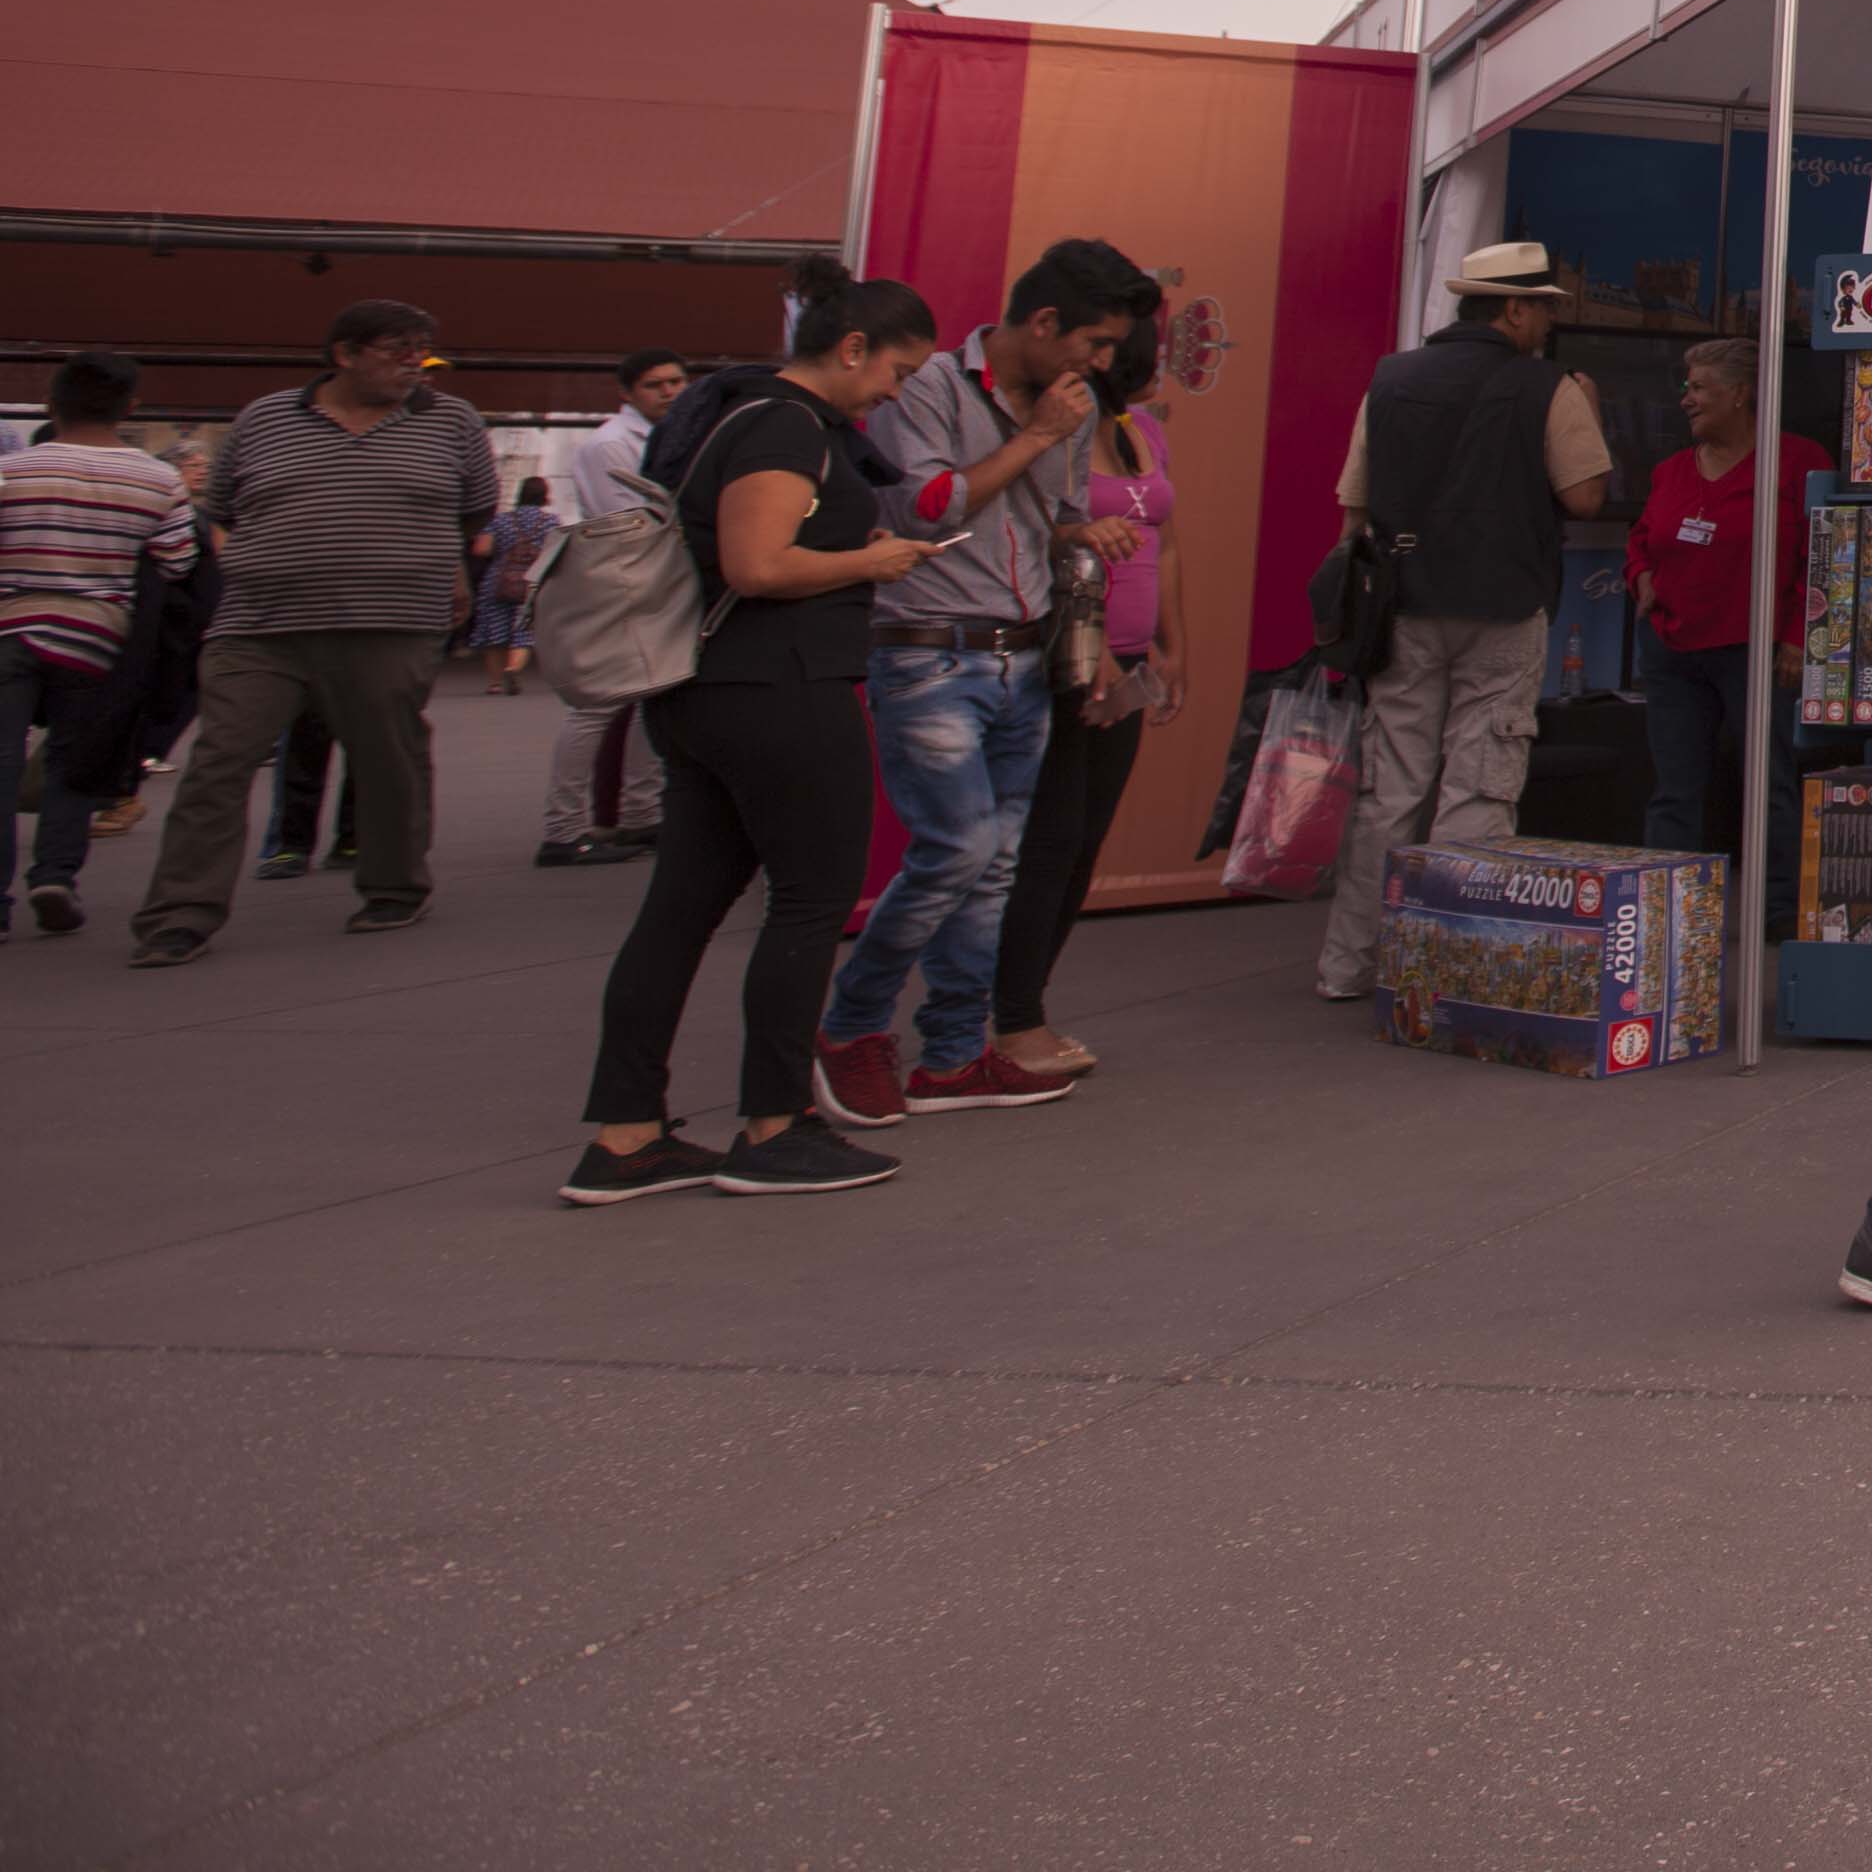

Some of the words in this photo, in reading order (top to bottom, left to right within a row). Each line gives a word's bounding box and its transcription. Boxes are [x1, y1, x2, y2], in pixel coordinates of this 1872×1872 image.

[1460, 885, 1504, 902] PUZZLE
[1504, 873, 1574, 910] 42000
[1605, 921, 1615, 972] PUZZLE
[1614, 903, 1638, 984] 42000
